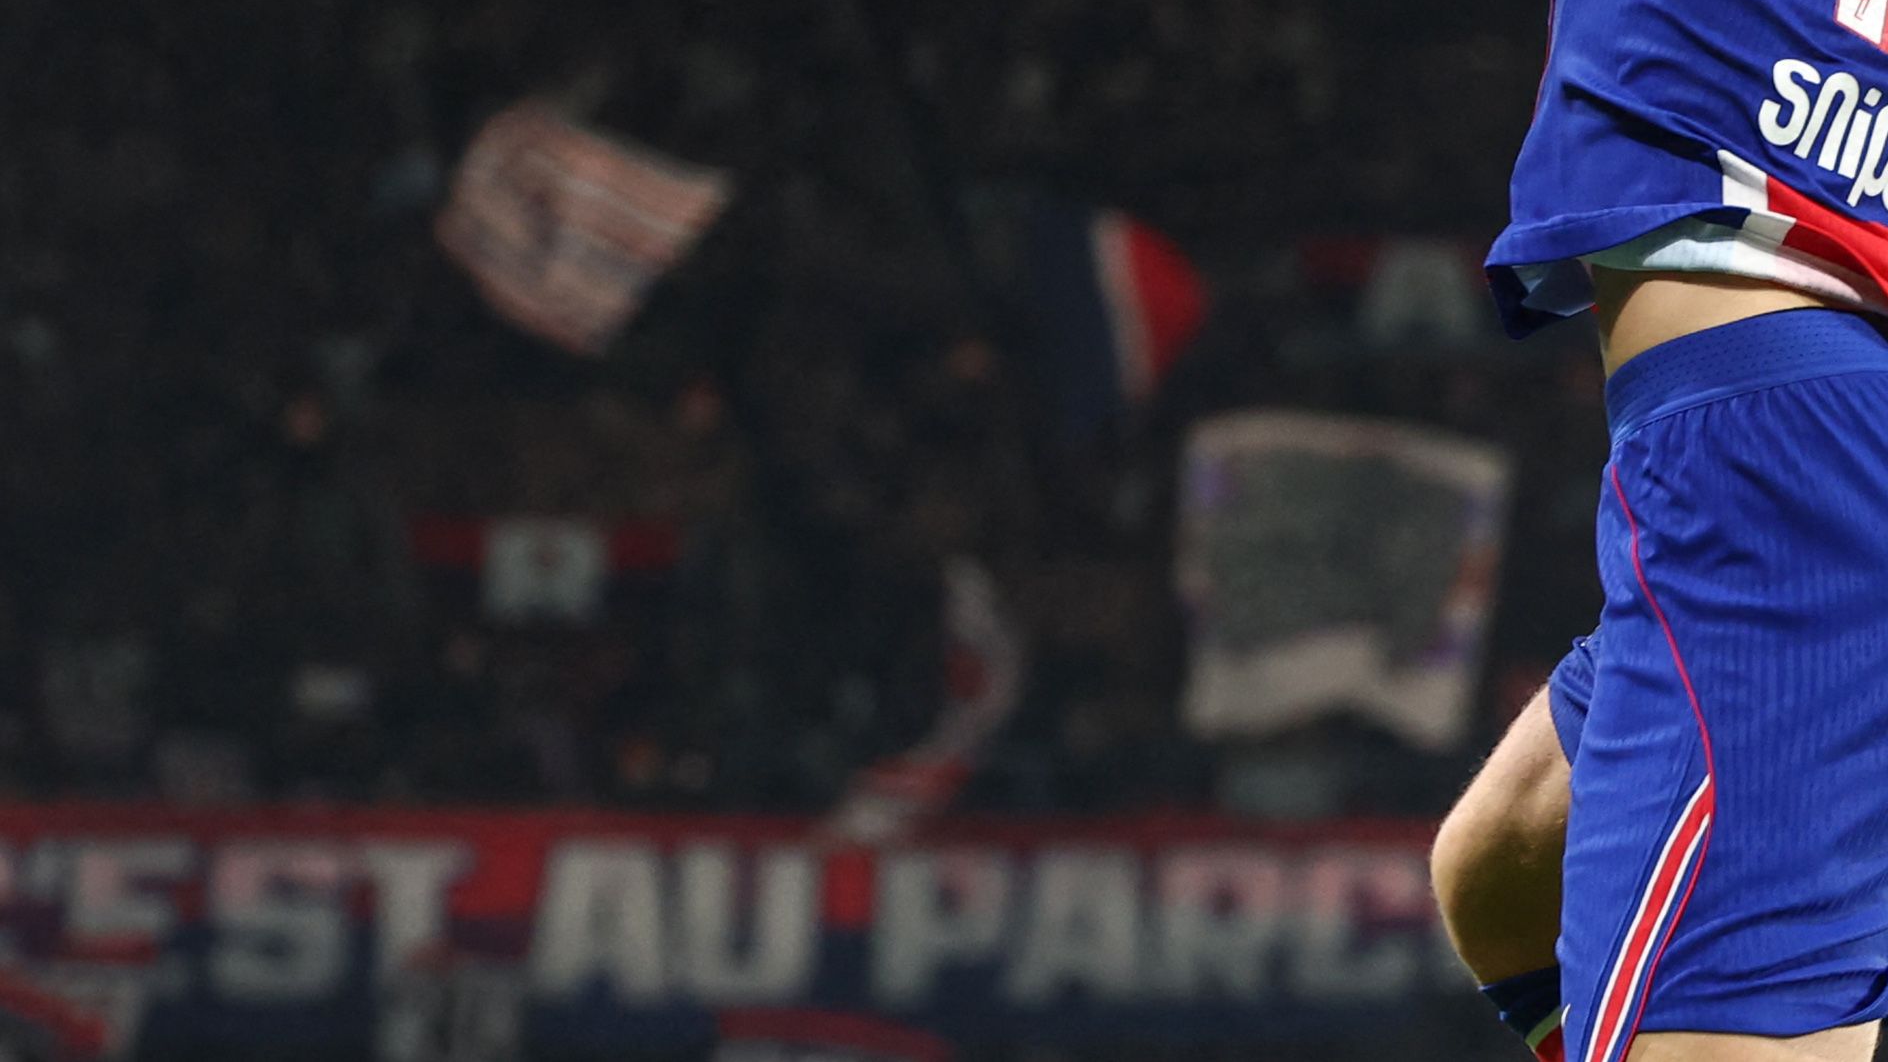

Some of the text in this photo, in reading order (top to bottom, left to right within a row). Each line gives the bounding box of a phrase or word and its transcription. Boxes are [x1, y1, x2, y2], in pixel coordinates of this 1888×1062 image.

[0, 841, 468, 996] 'EST
[532, 838, 812, 998] AU
[872, 840, 1440, 1000] PARC
